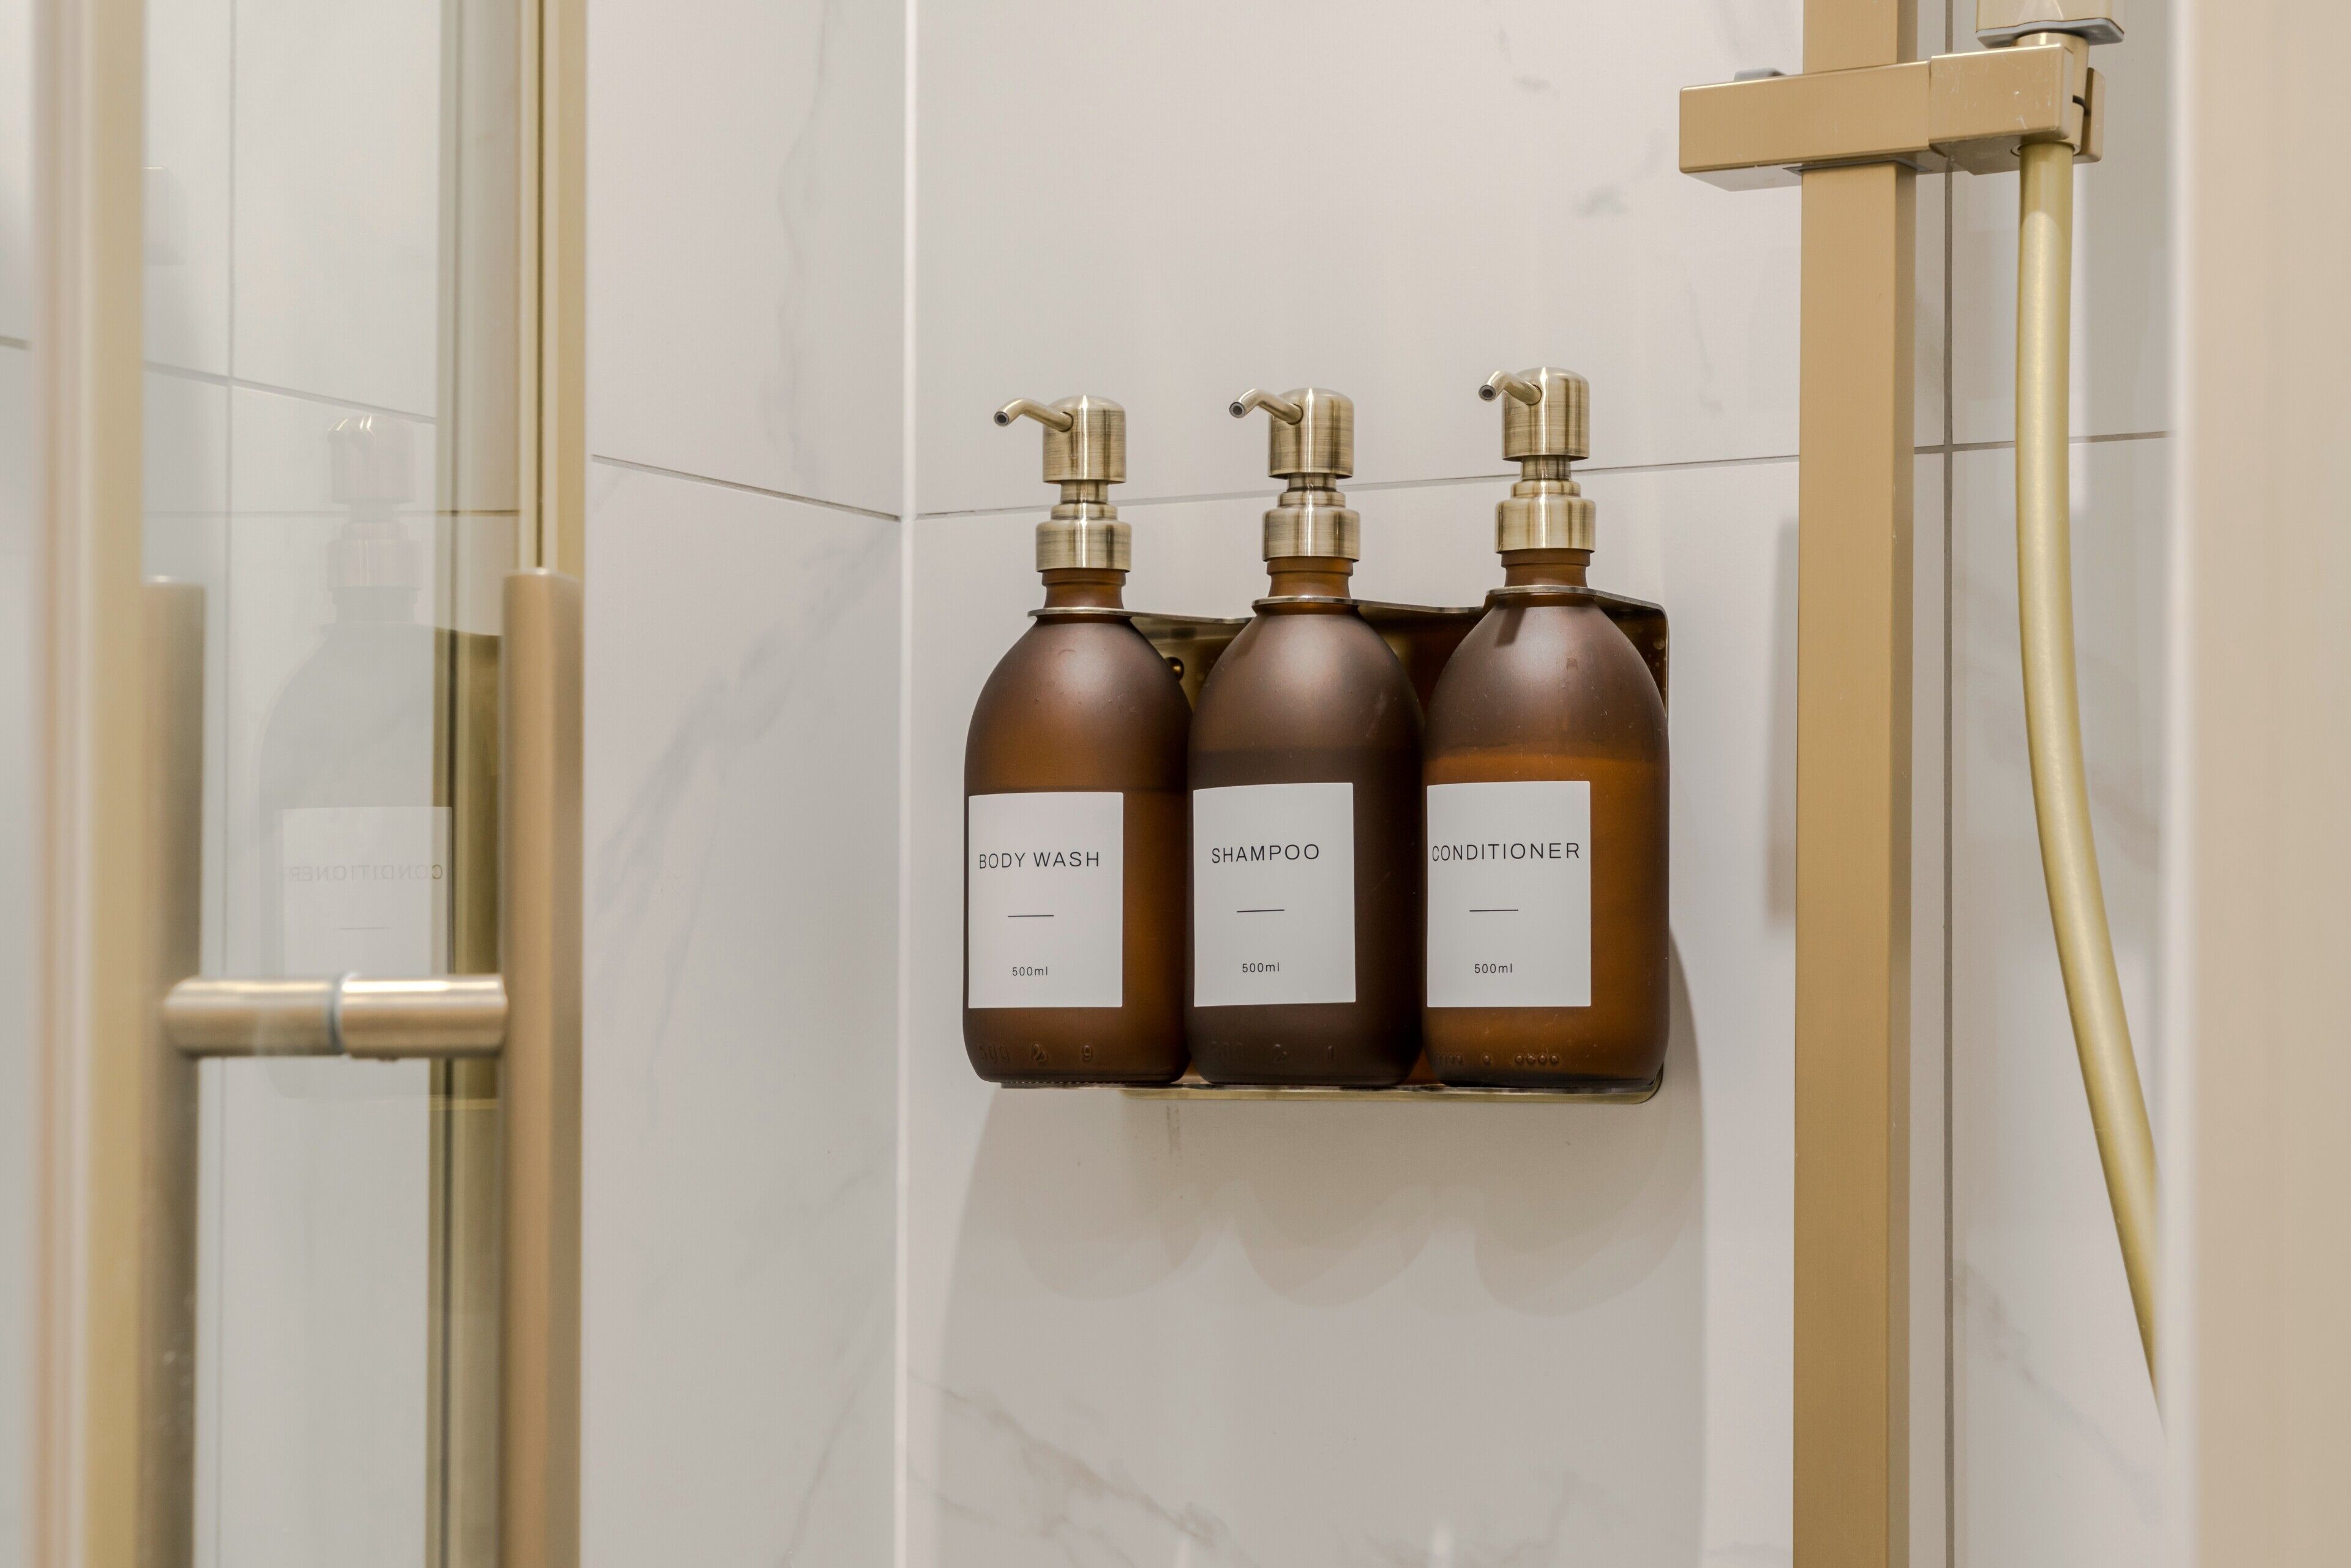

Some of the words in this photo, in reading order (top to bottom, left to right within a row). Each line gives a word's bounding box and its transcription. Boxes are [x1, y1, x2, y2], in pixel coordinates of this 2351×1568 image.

[1212, 844, 1320, 864] SHAMPOO
[1432, 842, 1580, 862] CONDITIONER
[979, 852, 1026, 869] BODY
[1032, 851, 1100, 868] WASH
[1012, 966, 1049, 977] 500ml
[1242, 961, 1280, 973] 500ml
[1474, 962, 1513, 974] 500ml
